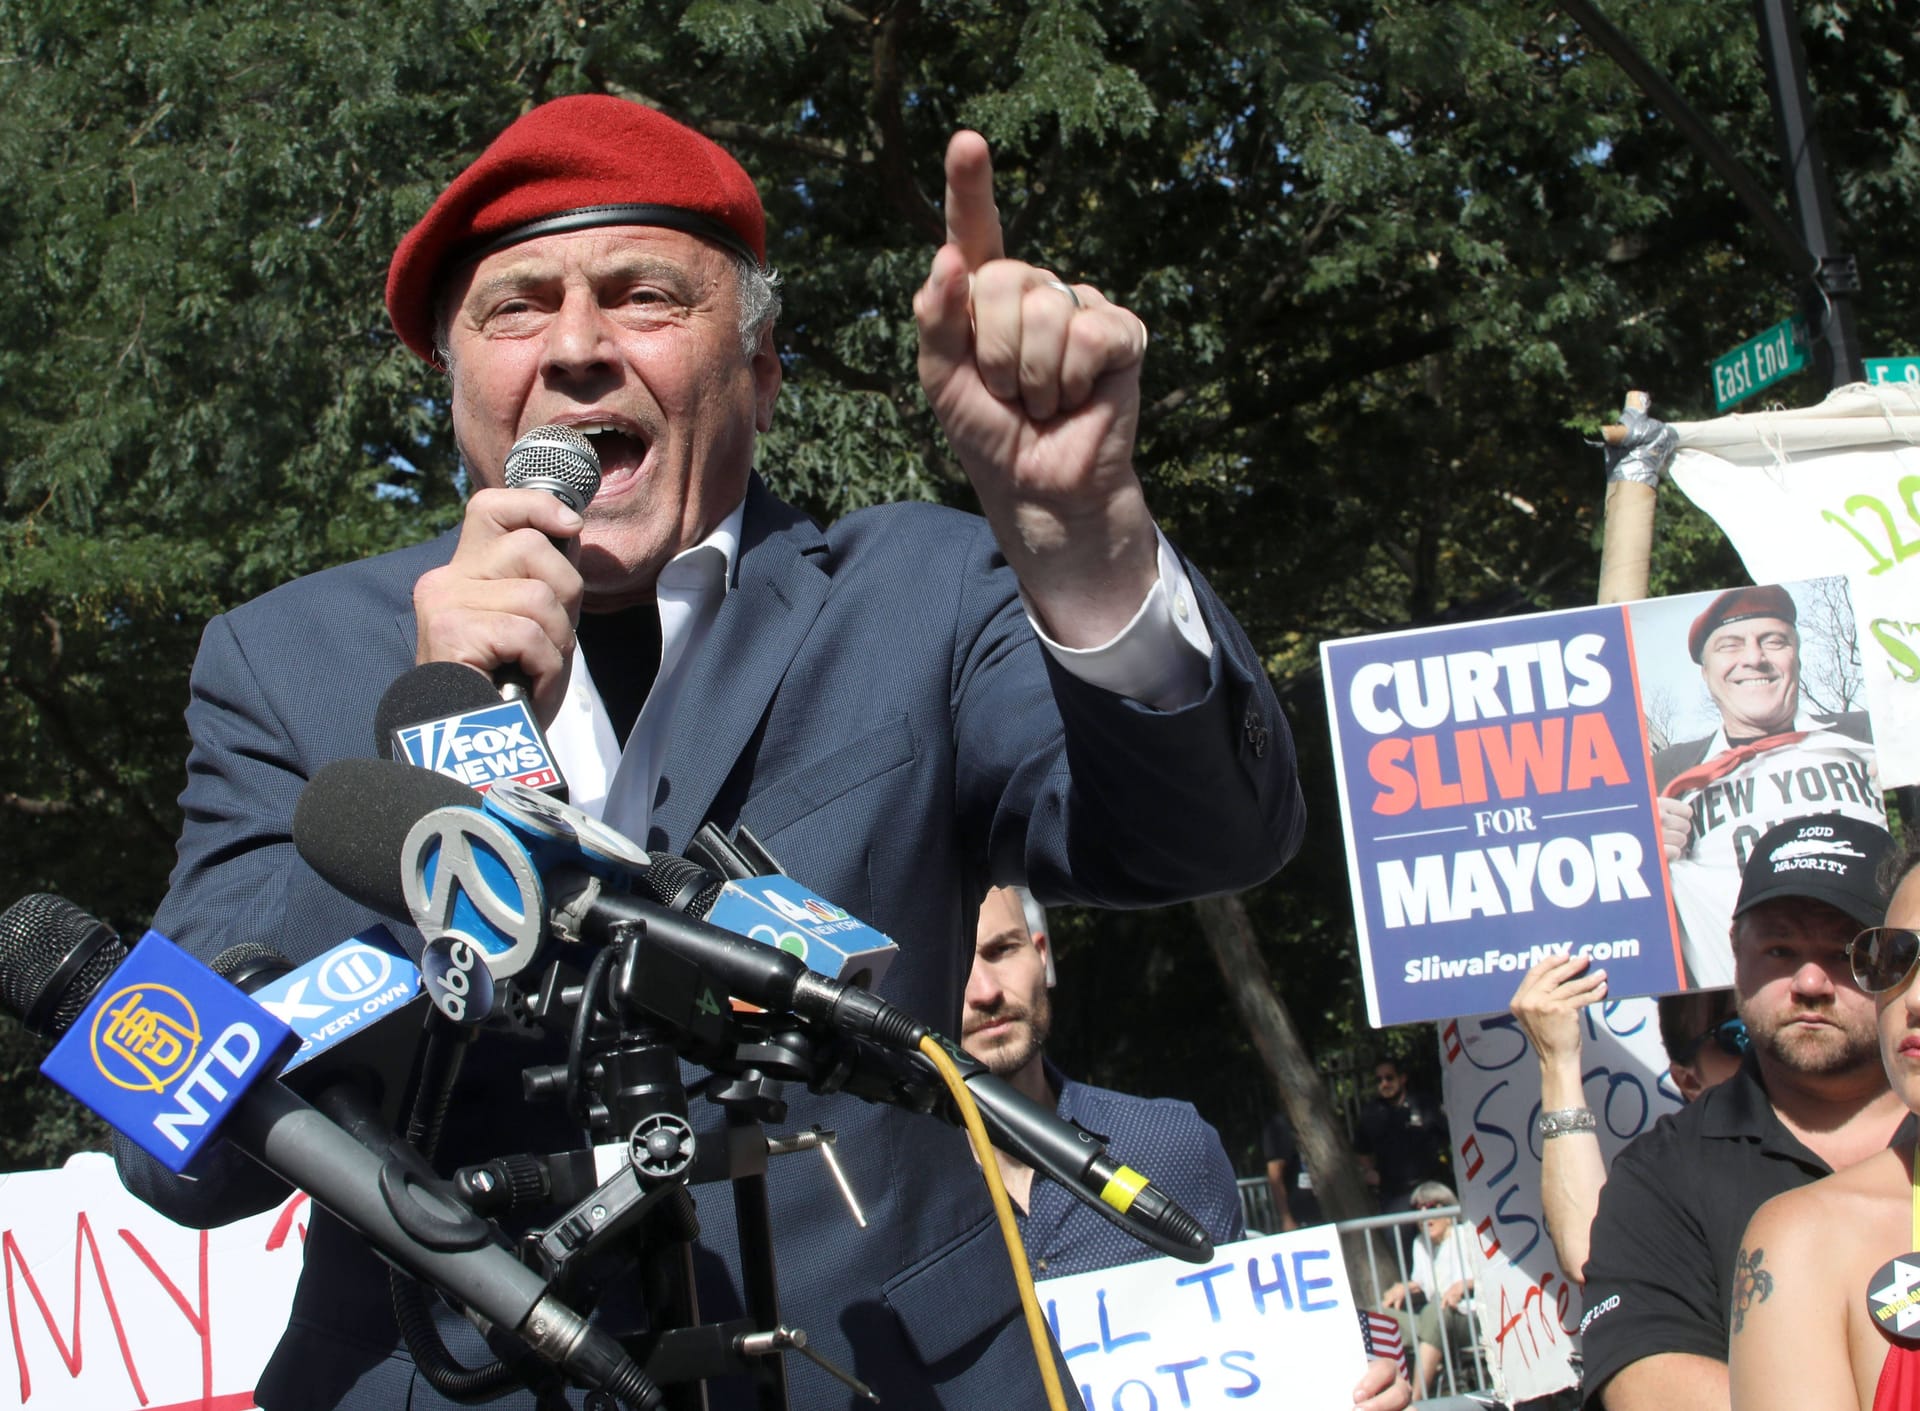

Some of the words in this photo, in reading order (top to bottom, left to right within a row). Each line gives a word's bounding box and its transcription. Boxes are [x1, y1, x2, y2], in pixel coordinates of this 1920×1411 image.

[1715, 351, 1753, 403] East
[1754, 327, 1789, 382] End
[1350, 634, 1612, 735] CURTIS
[436, 746, 543, 785] NEWS
[449, 721, 534, 761] FOX
[1367, 712, 1631, 816] SLIWA
[1769, 761, 1884, 814] YORK
[1474, 806, 1536, 837] FOR
[1798, 826, 1834, 839] LOUD
[1376, 832, 1651, 929] MAYOR
[1773, 858, 1848, 876] MAJORITY
[762, 889, 824, 925] 4
[437, 941, 475, 1021] abc
[1403, 938, 1640, 983] SliwaForNY.com
[311, 1008, 361, 1042] VERY
[363, 982, 409, 1014] OWN
[153, 1022, 260, 1151] NTD
[2, 1211, 212, 1407] MY
[1175, 1249, 1338, 1323] THE
[1593, 1294, 1621, 1319] LOUD
[1496, 1271, 1584, 1370] Arre
